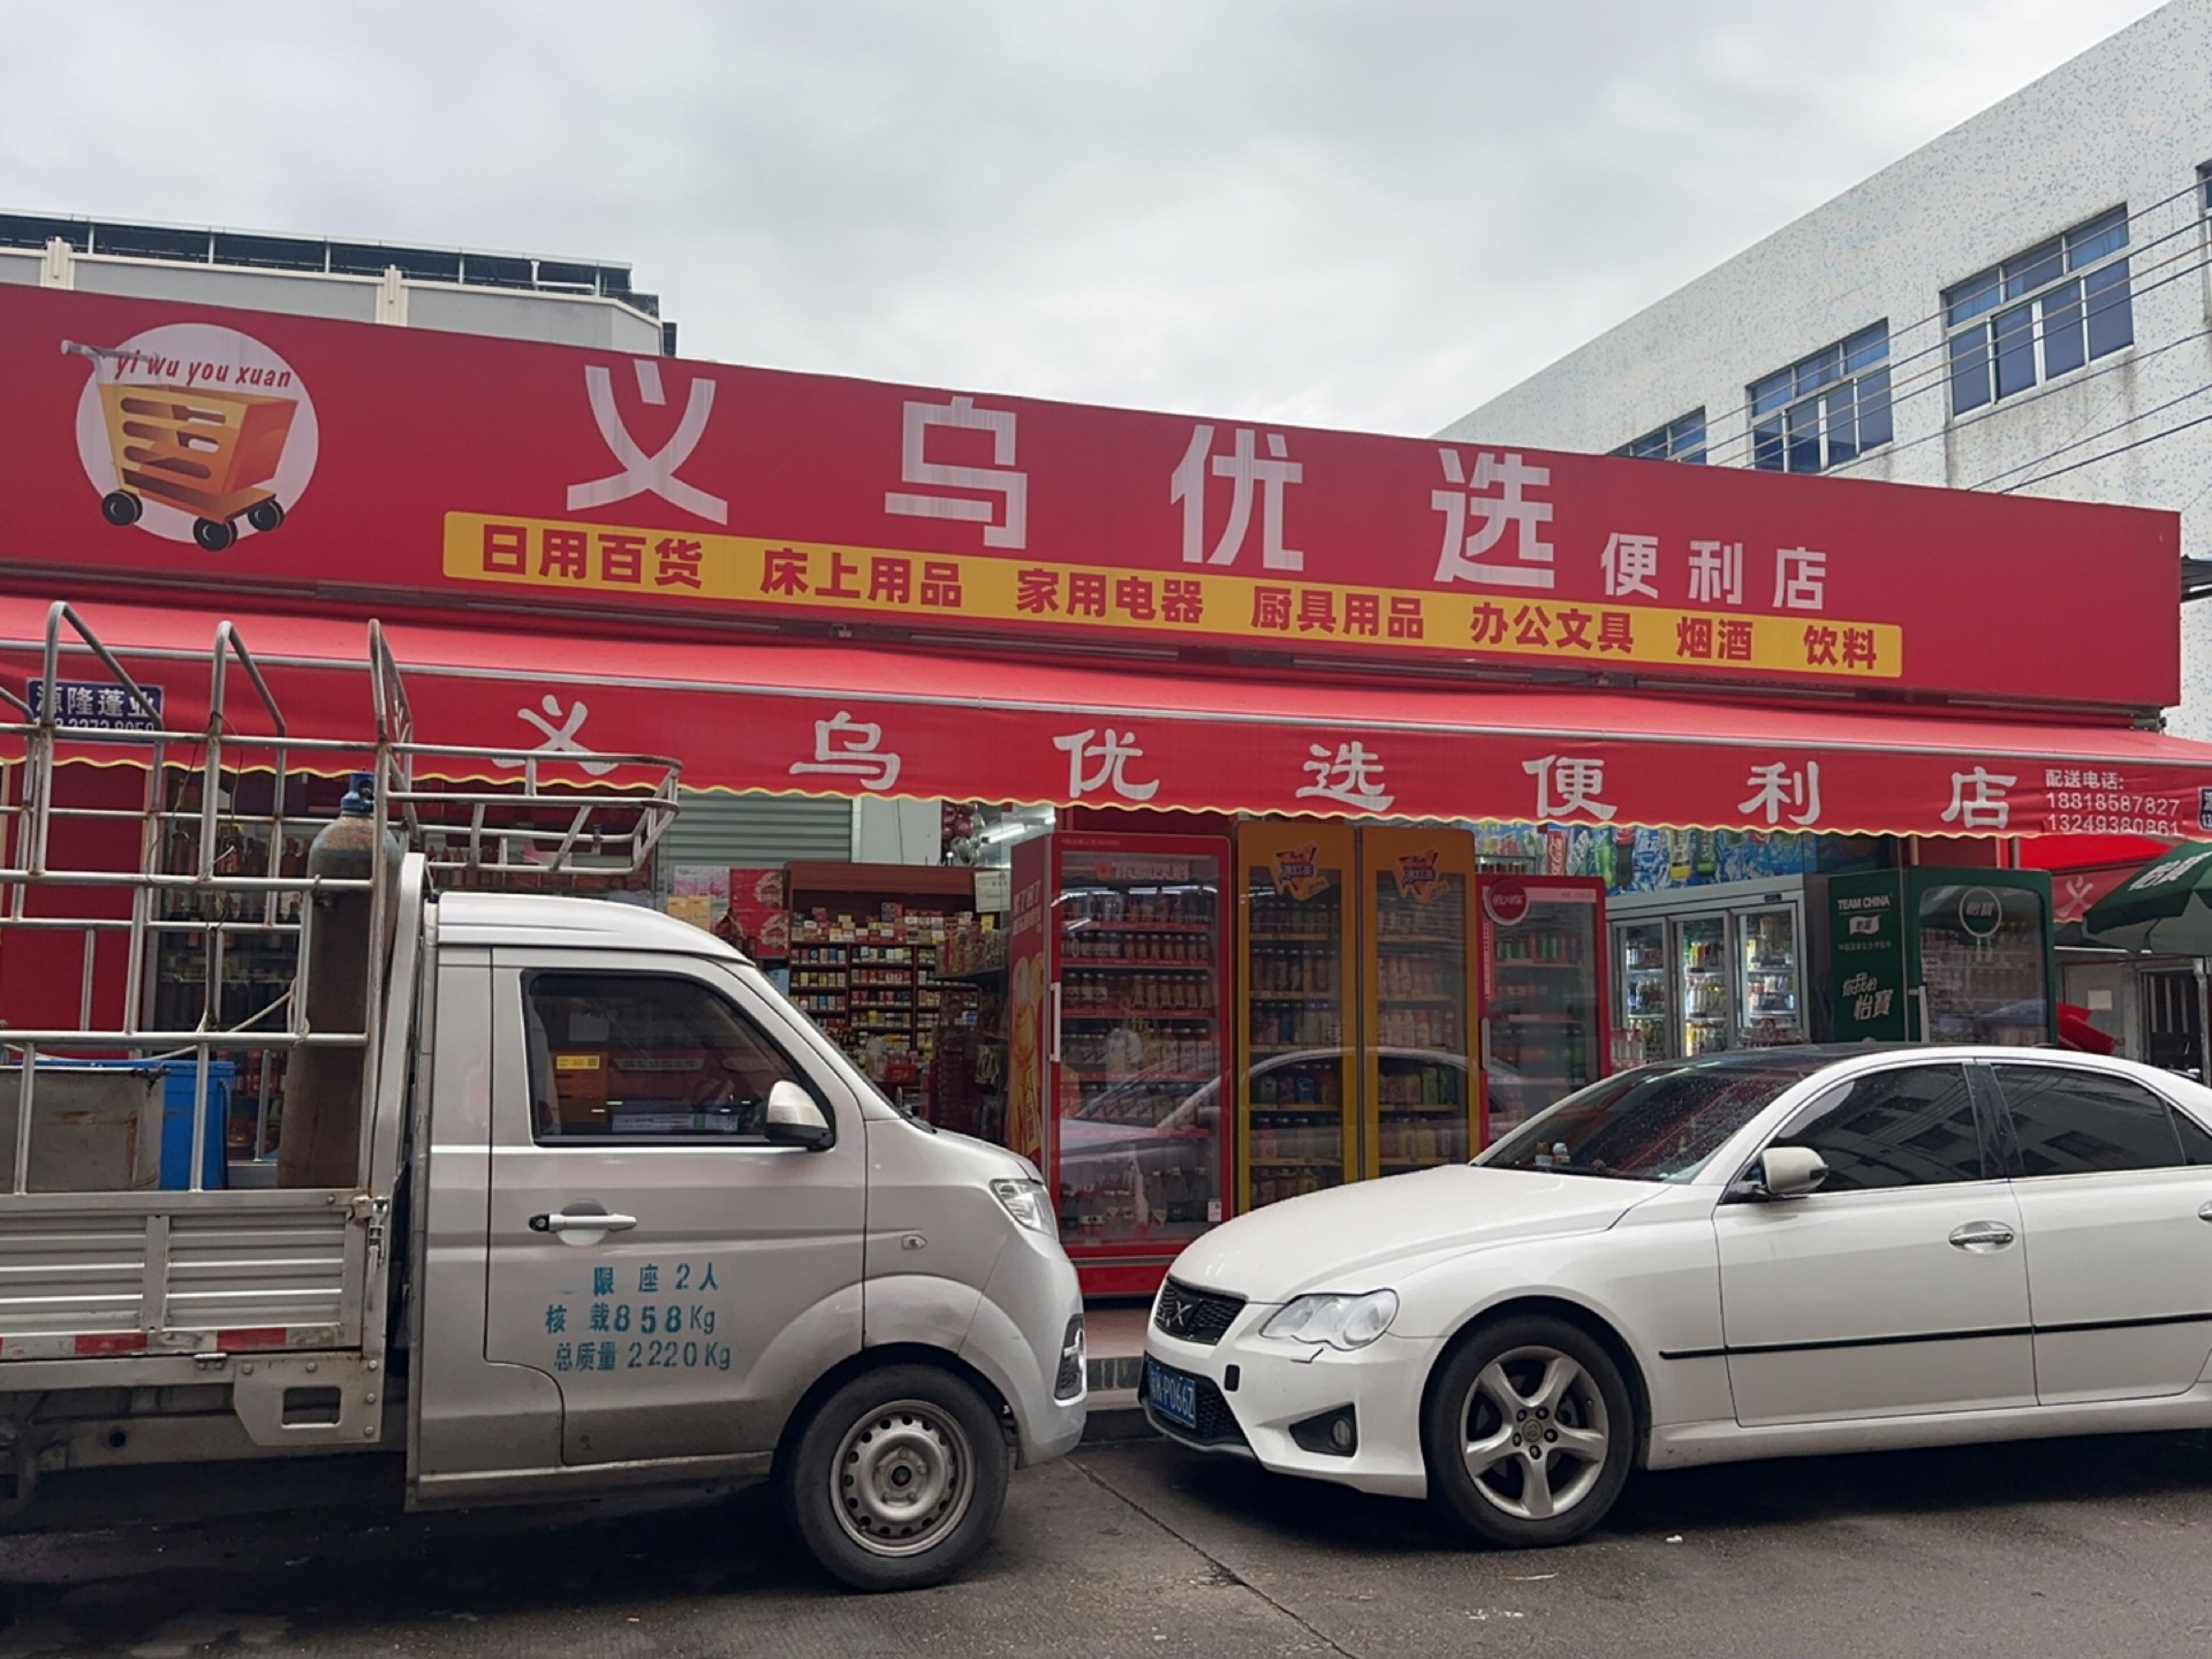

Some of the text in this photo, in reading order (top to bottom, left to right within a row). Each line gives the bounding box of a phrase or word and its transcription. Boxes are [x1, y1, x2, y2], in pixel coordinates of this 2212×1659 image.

[115, 349, 291, 388] yi wu you xuan
[567, 359, 1827, 610] 义乌优选 便利店
[483, 523, 1877, 670] 日用百货 床上用品 家用电器 厨具用品 办公文具 烟酒 饮料
[2046, 792, 2181, 817] 18818587827
[1837, 894, 1890, 910] TEAM CHINA
